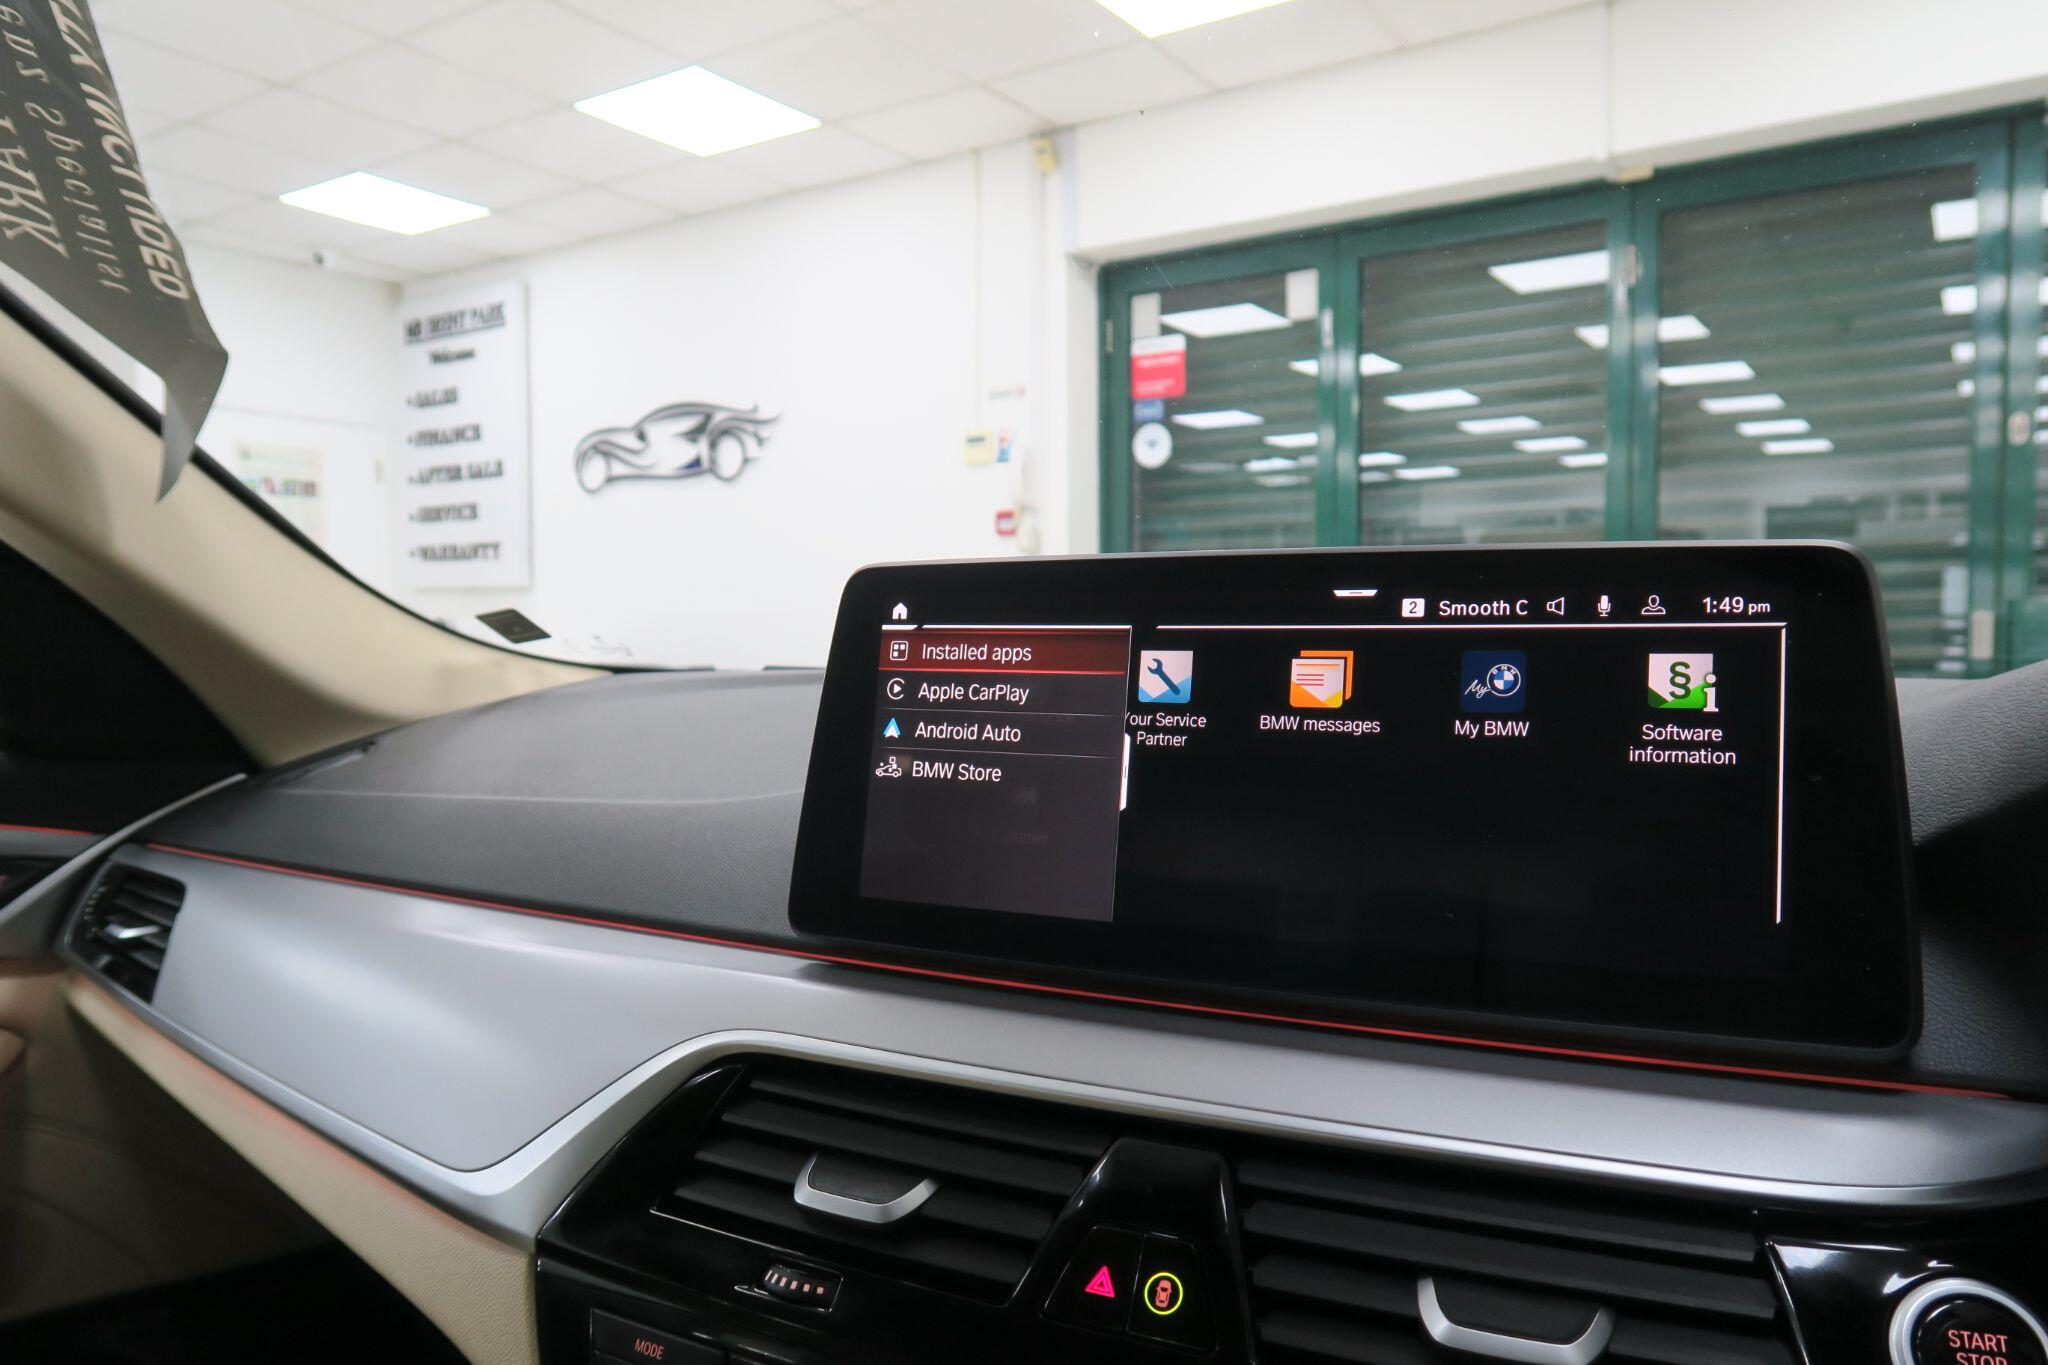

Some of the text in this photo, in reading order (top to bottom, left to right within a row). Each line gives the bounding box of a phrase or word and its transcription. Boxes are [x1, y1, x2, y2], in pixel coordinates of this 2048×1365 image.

[1439, 600, 1510, 616] Smooth
[1516, 600, 1528, 615] C
[1703, 596, 1771, 616] 1:49 pm
[922, 643, 1032, 664] Installed apps
[918, 682, 1030, 705] Apple CarPlay
[1156, 713, 1207, 728] Service
[1260, 715, 1380, 736] BMW messages
[1455, 720, 1529, 739] My BMW
[915, 721, 1021, 743] Android Auto
[1136, 731, 1187, 747] Partner
[1642, 724, 1723, 742] Software
[1629, 746, 1737, 765] information
[912, 761, 1002, 782] BMW Store
[634, 1338, 664, 1360] MODE
[1948, 1329, 2008, 1353] START
